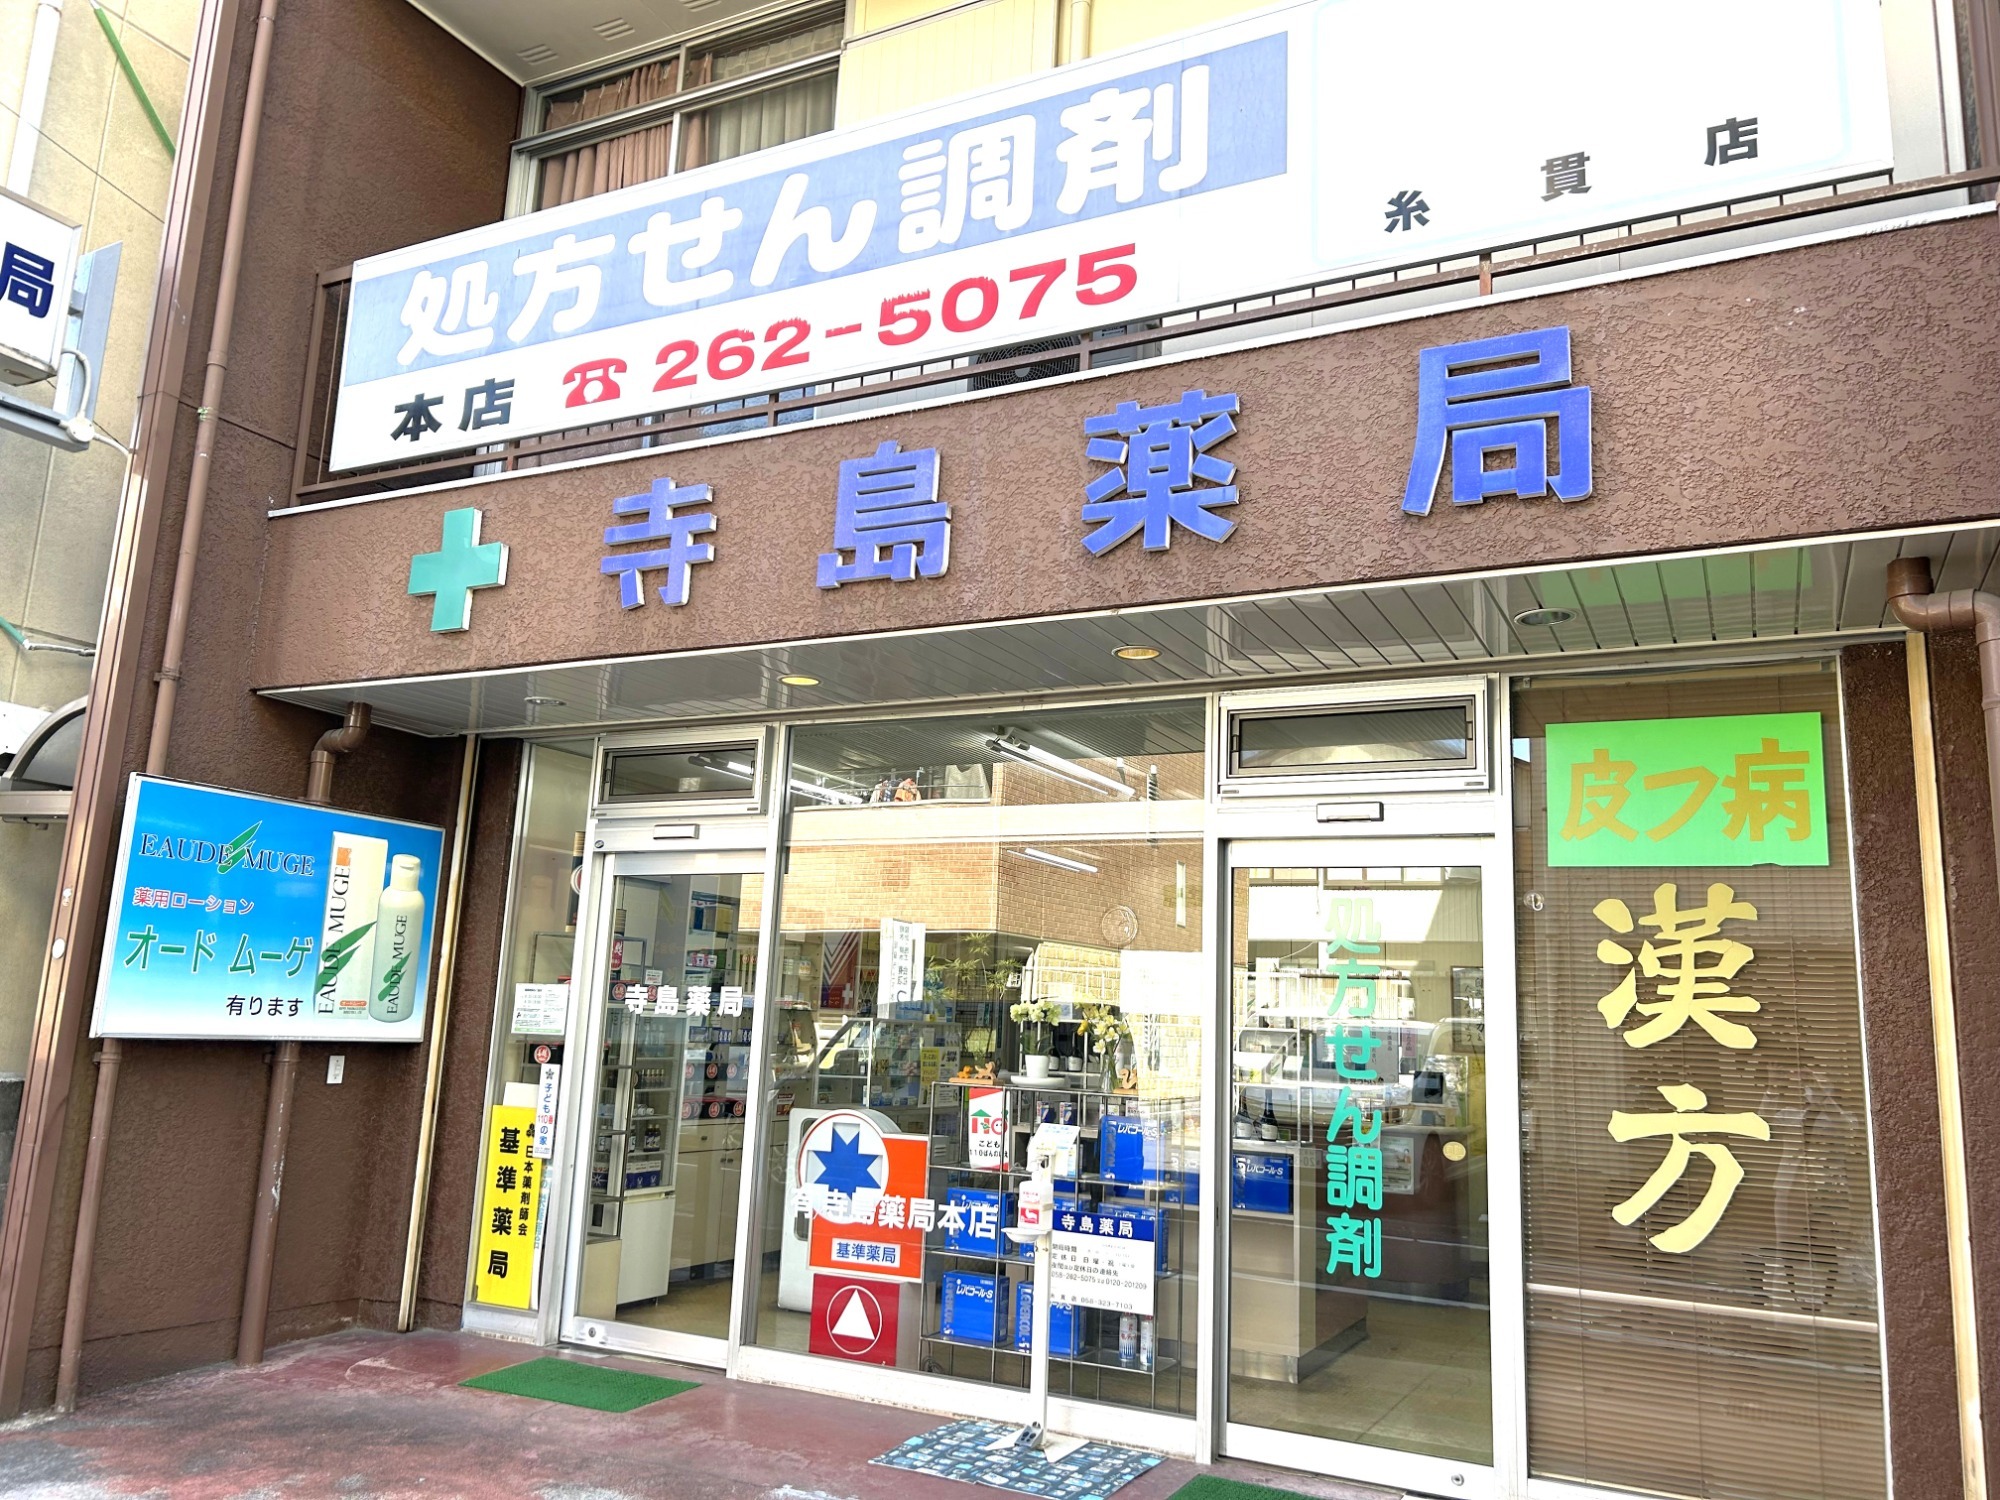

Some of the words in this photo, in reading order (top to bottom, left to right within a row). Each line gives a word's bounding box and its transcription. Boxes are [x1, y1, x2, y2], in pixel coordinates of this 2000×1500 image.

[1384, 117, 1758, 233] 糸貫店
[398, 64, 1210, 367] 処方せん調剤
[0, 241, 55, 318] 局
[653, 243, 1138, 392] 262-5075
[390, 377, 515, 443] 本店
[600, 325, 1592, 611] 寺島薬局
[1560, 738, 1810, 842] 皮フ病
[139, 832, 234, 866] EAUDE
[243, 848, 316, 876] MUGE
[132, 887, 255, 915] 薬用ローション
[328, 867, 350, 934] MUGE
[124, 924, 217, 974] オード
[228, 933, 315, 977] ムーゲ
[393, 915, 408, 960] MUGE
[226, 995, 304, 1017] 有ります
[625, 984, 744, 1017] 寺島薬局
[1325, 897, 1382, 1277] 処方せん調剤
[1593, 882, 1770, 1253] 漢方
[978, 1139, 1000, 1149] こども
[487, 1126, 521, 1280] 基準薬局
[518, 1146, 534, 1237] 日本薬剤師会
[836, 1241, 897, 1264] 基準薬局
[1061, 1213, 1134, 1238] 寺島薬局
